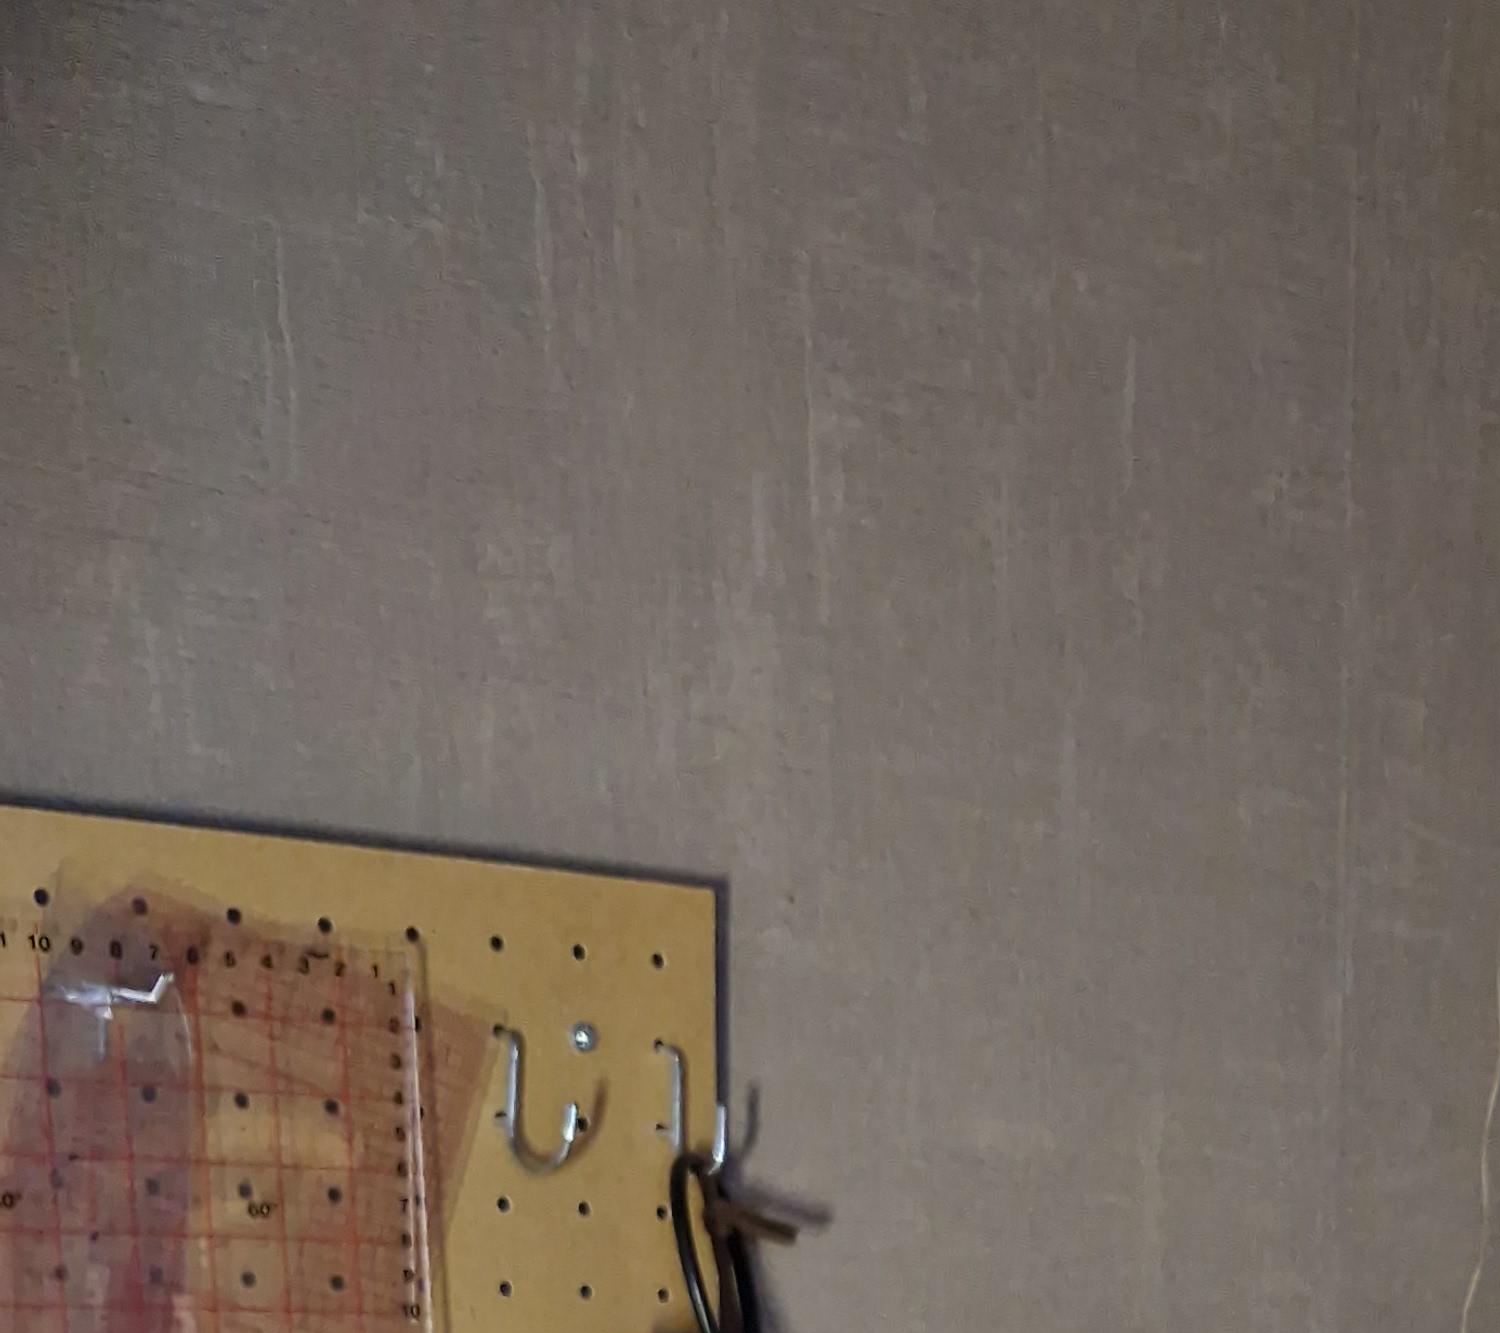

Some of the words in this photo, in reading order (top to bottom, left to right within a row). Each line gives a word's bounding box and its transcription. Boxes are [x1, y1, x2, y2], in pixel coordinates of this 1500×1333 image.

[28, 933, 51, 952] 10
[70, 937, 83, 955] 9
[149, 944, 158, 961] 7
[402, 1303, 421, 1321] 10
